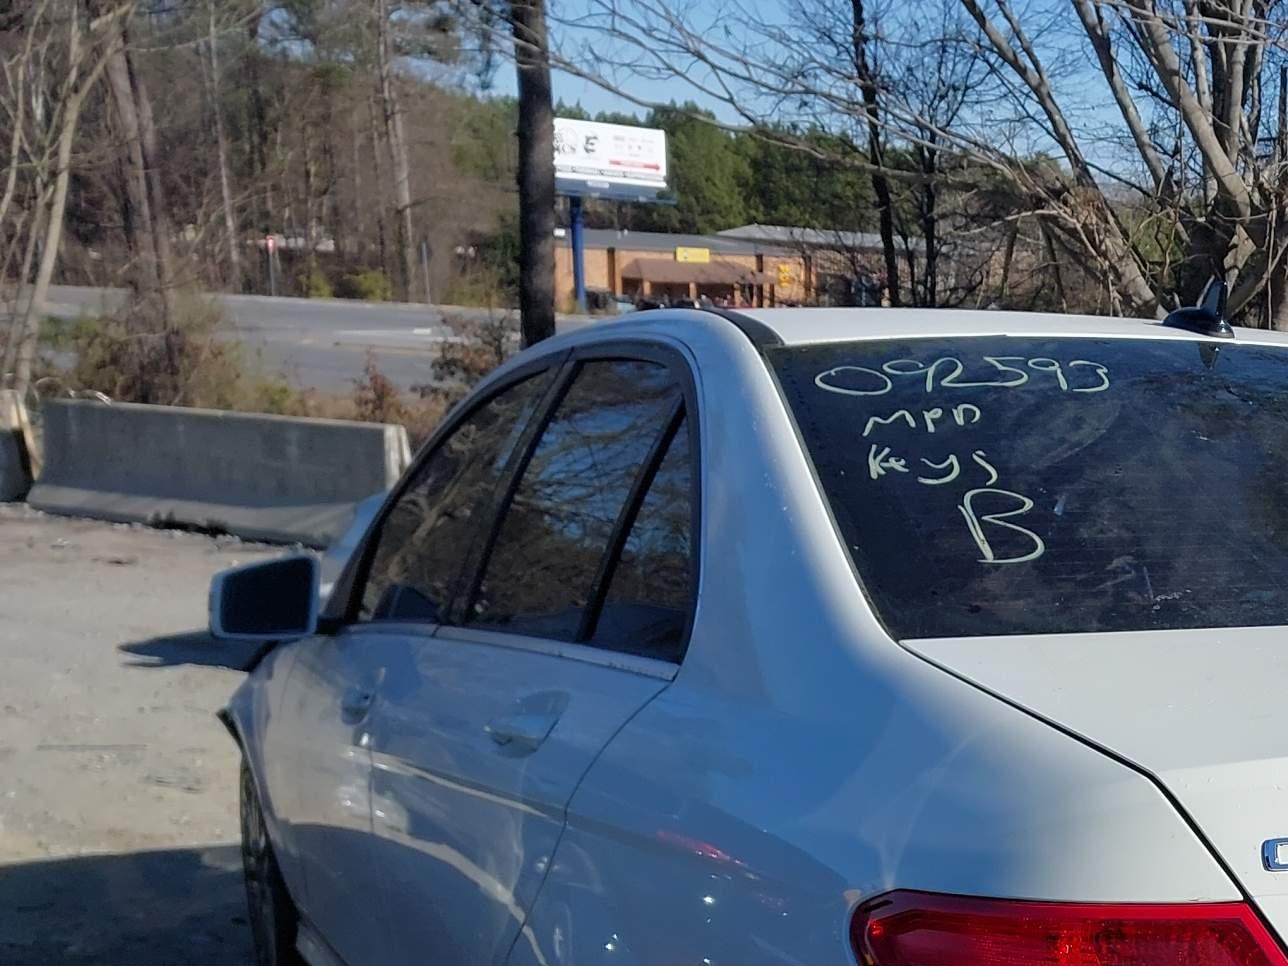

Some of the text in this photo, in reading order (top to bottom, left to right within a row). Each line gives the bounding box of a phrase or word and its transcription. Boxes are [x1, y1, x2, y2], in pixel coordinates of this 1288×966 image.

[814, 356, 1110, 396] 092593
[866, 444, 998, 485] Keys
[957, 488, 1045, 563] B
